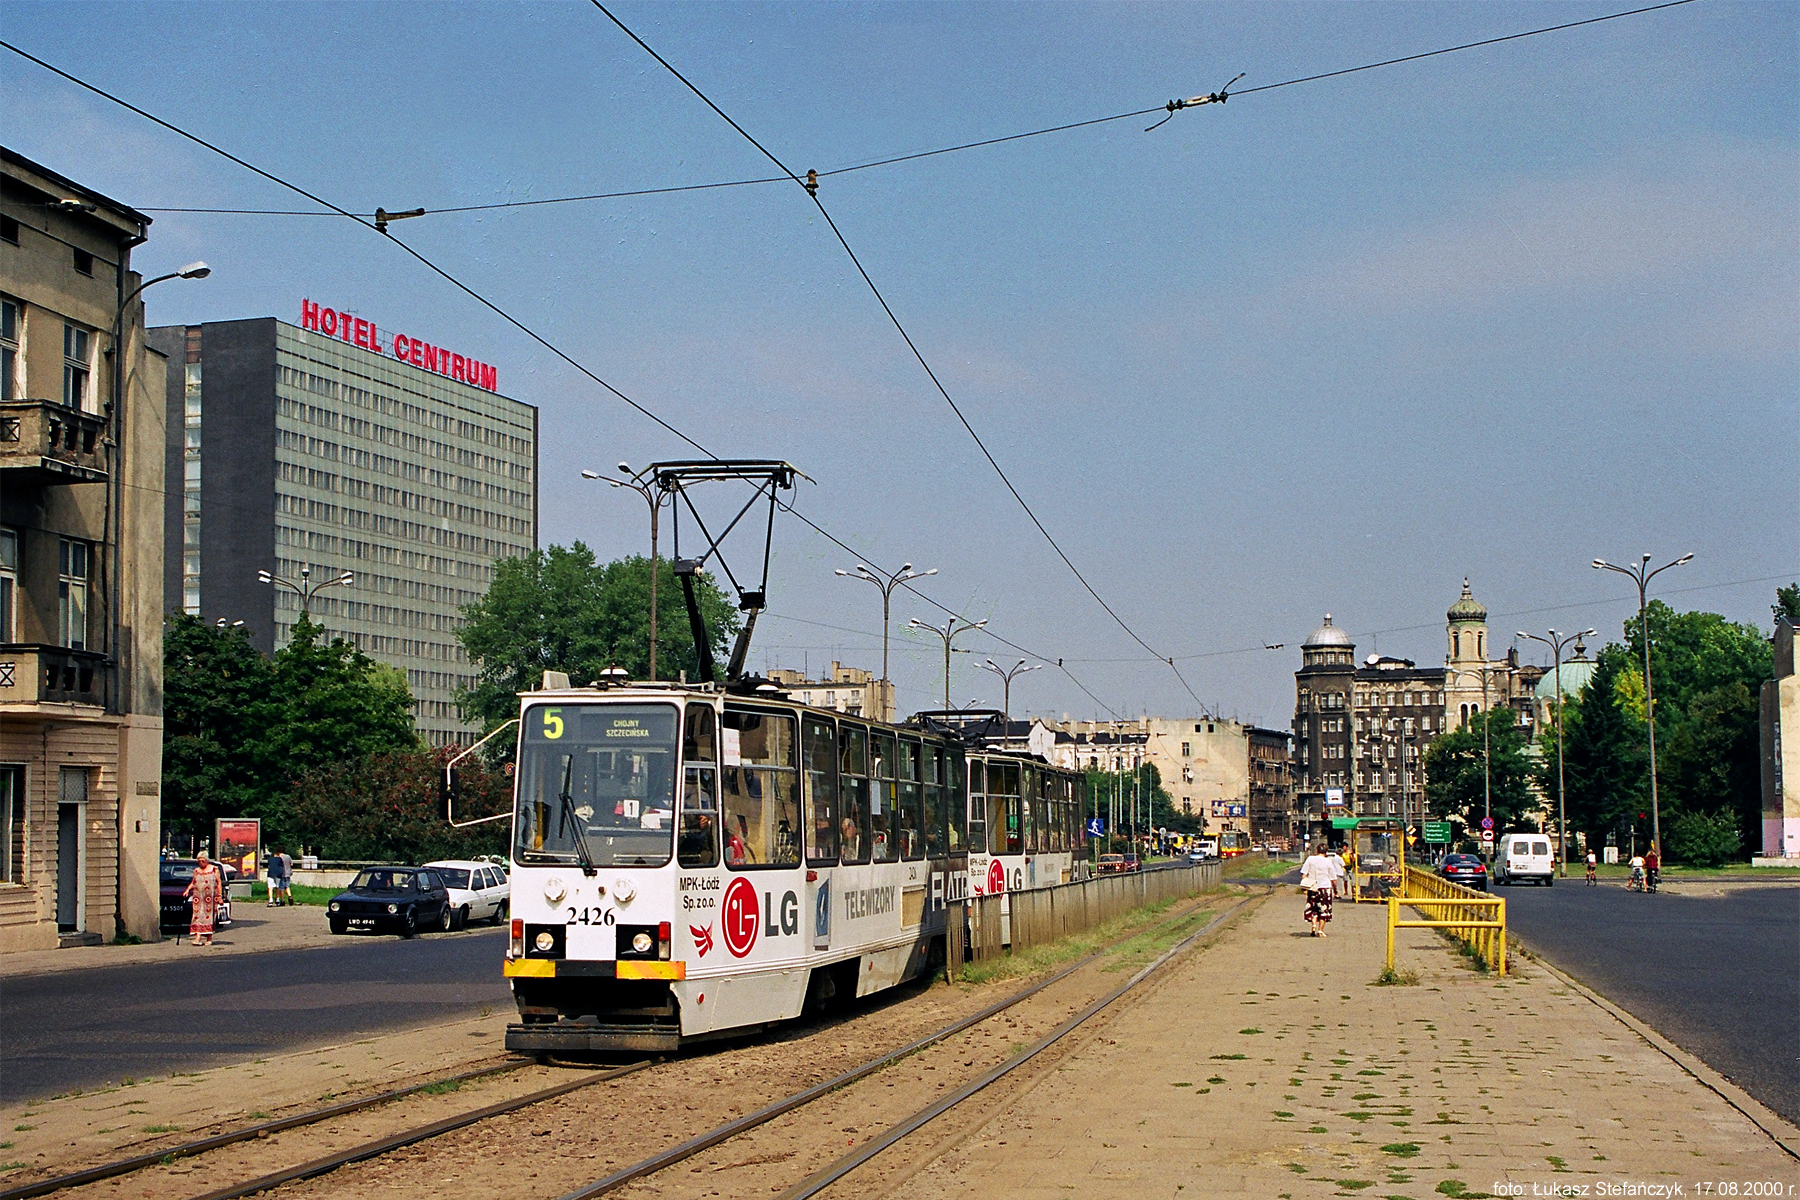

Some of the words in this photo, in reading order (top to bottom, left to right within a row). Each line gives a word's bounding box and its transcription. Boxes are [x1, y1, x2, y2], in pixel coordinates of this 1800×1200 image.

[302, 298, 382, 353] HOTEL
[393, 333, 498, 392] CENTRUM
[543, 708, 564, 739] 5
[605, 727, 650, 737] SZCZECIŃSKA
[613, 719, 640, 728] CHOJNY
[679, 876, 720, 891] MPK-Łódź
[1006, 867, 1022, 891] LG
[765, 890, 798, 937] LG
[844, 885, 896, 920] TELEWIZORY
[566, 907, 615, 926] 2426
